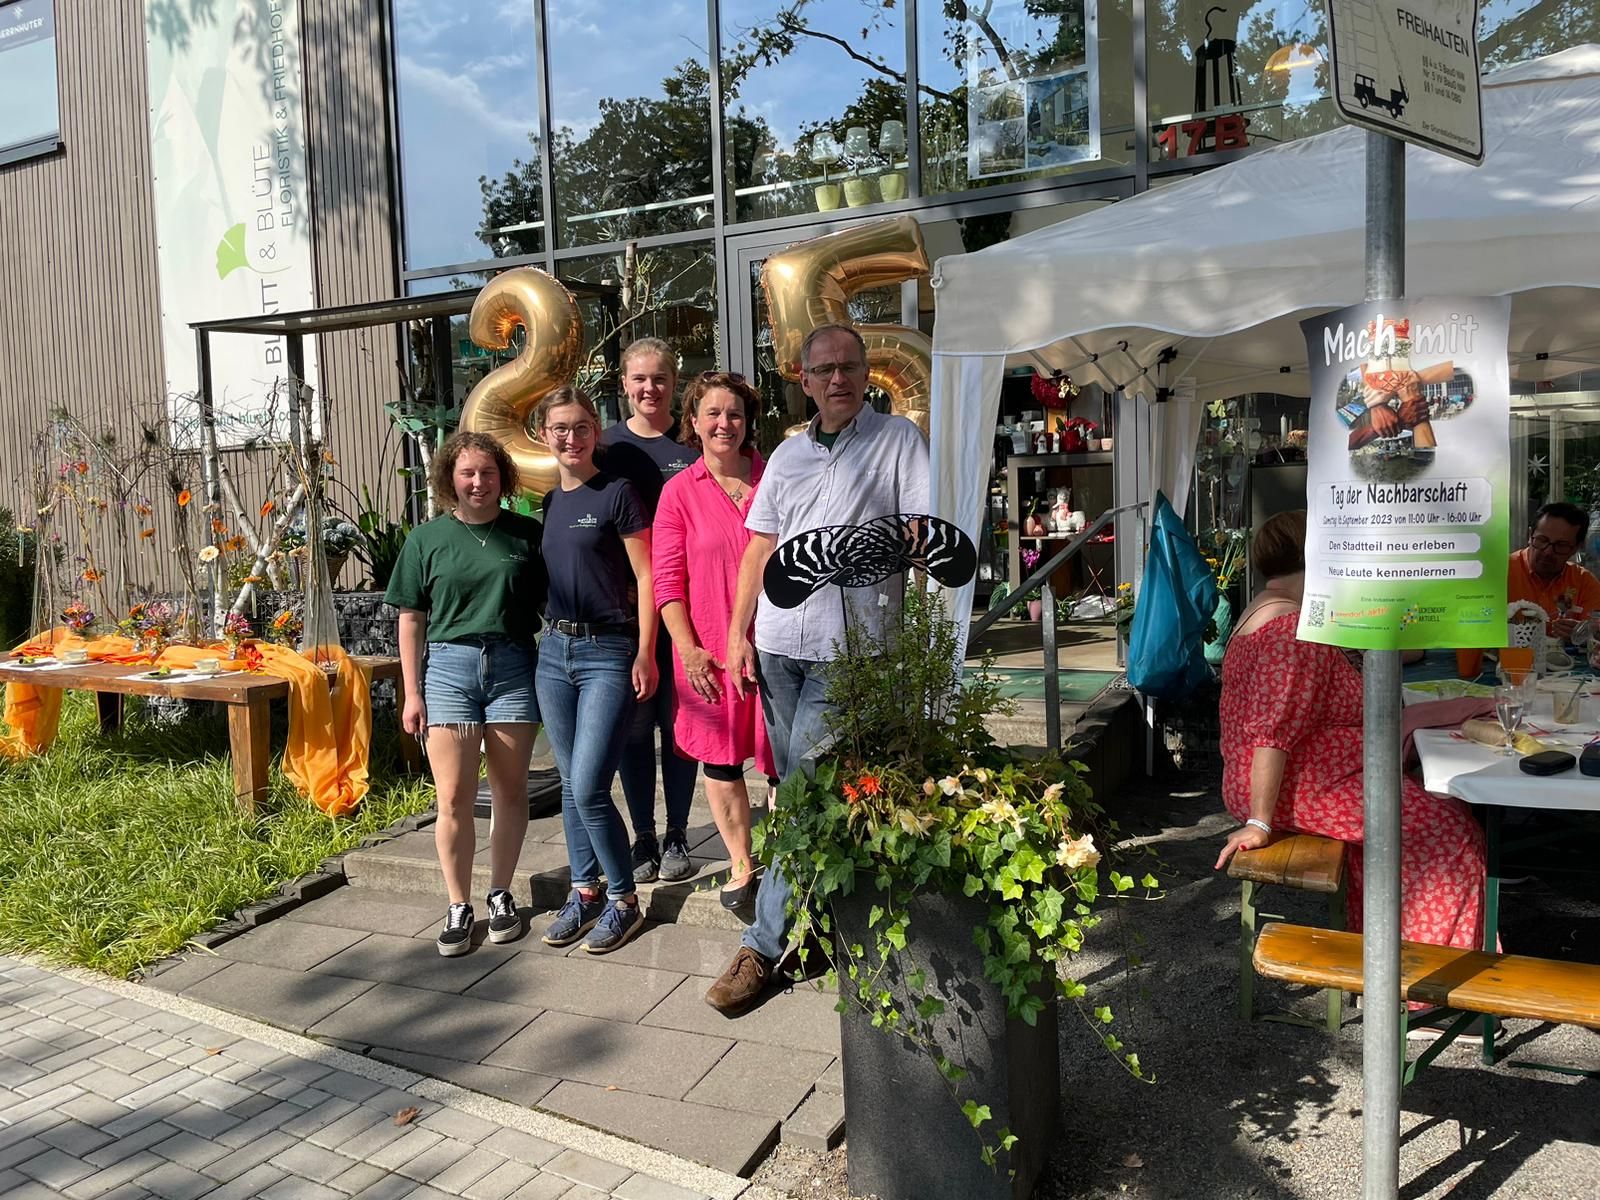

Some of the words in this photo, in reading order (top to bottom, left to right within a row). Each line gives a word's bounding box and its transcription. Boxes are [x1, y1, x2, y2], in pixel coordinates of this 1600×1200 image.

[0, 17, 45, 39] ERRNHUTER
[1397, 8, 1469, 57] FREIHALTEN
[270, 0, 286, 101] FRIEDHOF
[276, 106, 287, 119] &
[252, 144, 274, 231] BLÜTE
[276, 126, 294, 227] FLORISTIK
[260, 241, 276, 259] &
[261, 279, 282, 365] BLTT
[1324, 314, 1395, 367] Mach
[1415, 313, 1479, 354] mit
[1331, 485, 1345, 509] Tag
[1346, 485, 1362, 505] der
[1367, 481, 1468, 504] Nachbarschaft
[1371, 514, 1392, 525] 2023
[1394, 516, 1406, 524] von
[1408, 513, 1425, 524] 11:00
[1427, 513, 1440, 523] Uhr
[1447, 512, 1467, 523] 16:00
[1469, 511, 1482, 522] Uhr
[1329, 540, 1341, 551] Den
[1342, 540, 1383, 552] Stadtteil
[1386, 542, 1409, 551] neu
[1412, 540, 1455, 550] erleben
[1328, 566, 1344, 577] Neue
[1345, 567, 1373, 578] Leute
[1376, 567, 1456, 578] kennenlernen
